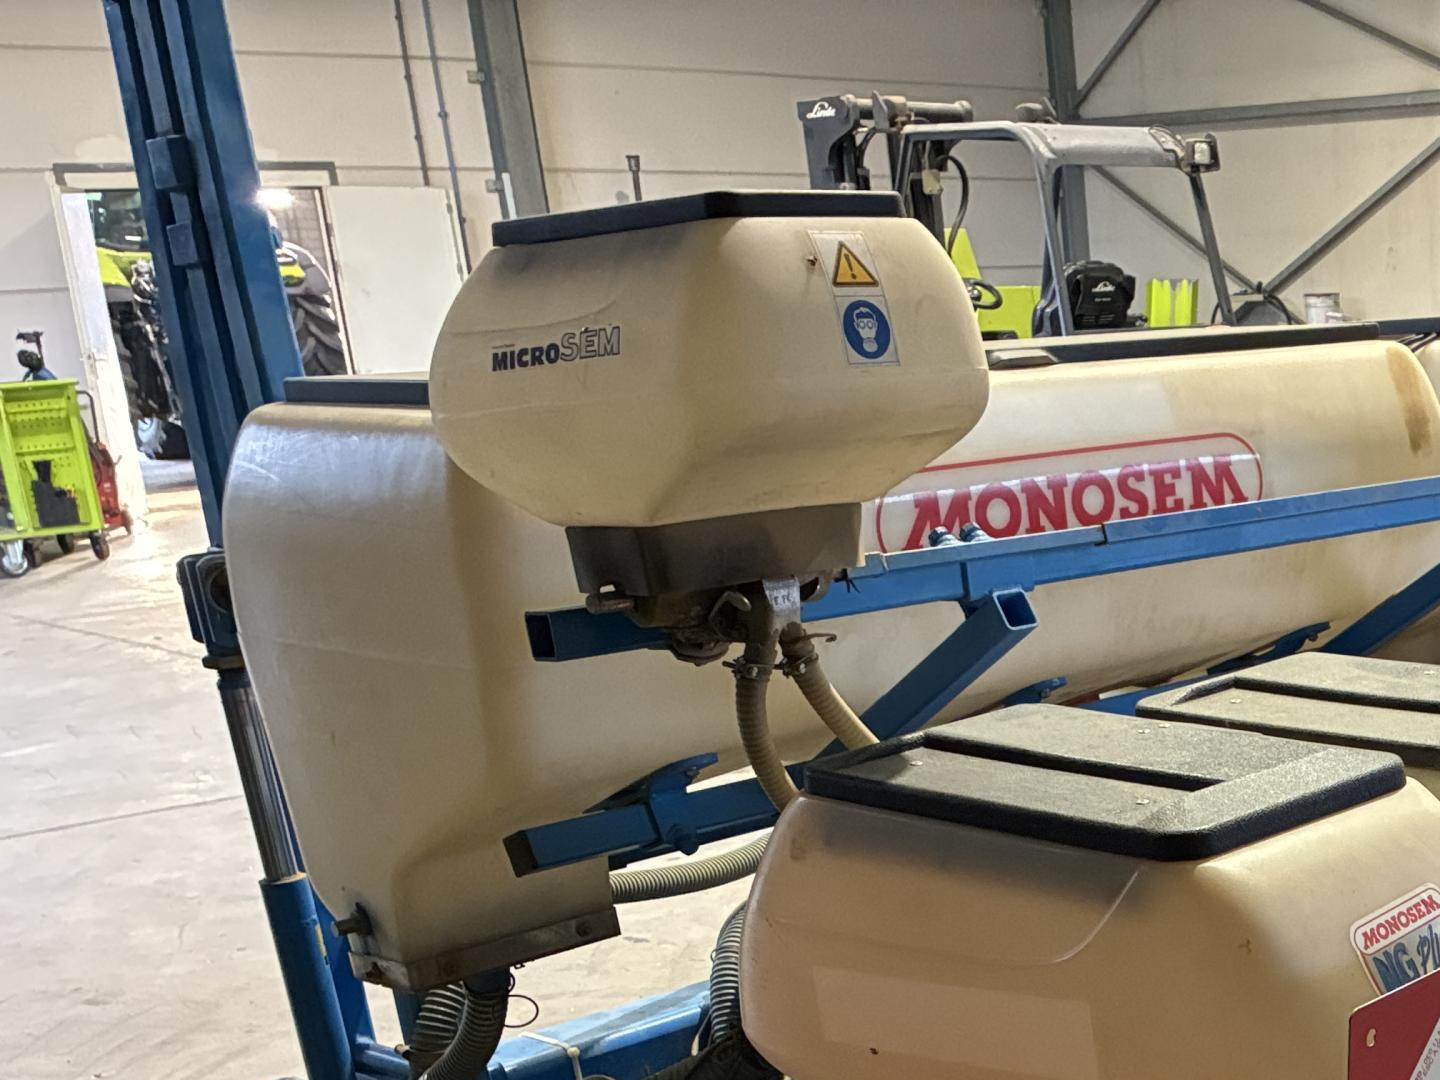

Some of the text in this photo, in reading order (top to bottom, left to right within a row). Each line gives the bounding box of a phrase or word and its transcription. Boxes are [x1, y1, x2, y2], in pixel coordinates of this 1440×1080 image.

[806, 101, 836, 119] Linde
[492, 326, 621, 372] MICROSEM
[902, 454, 1249, 551] MONOSEM
[1372, 942, 1420, 993] NG
